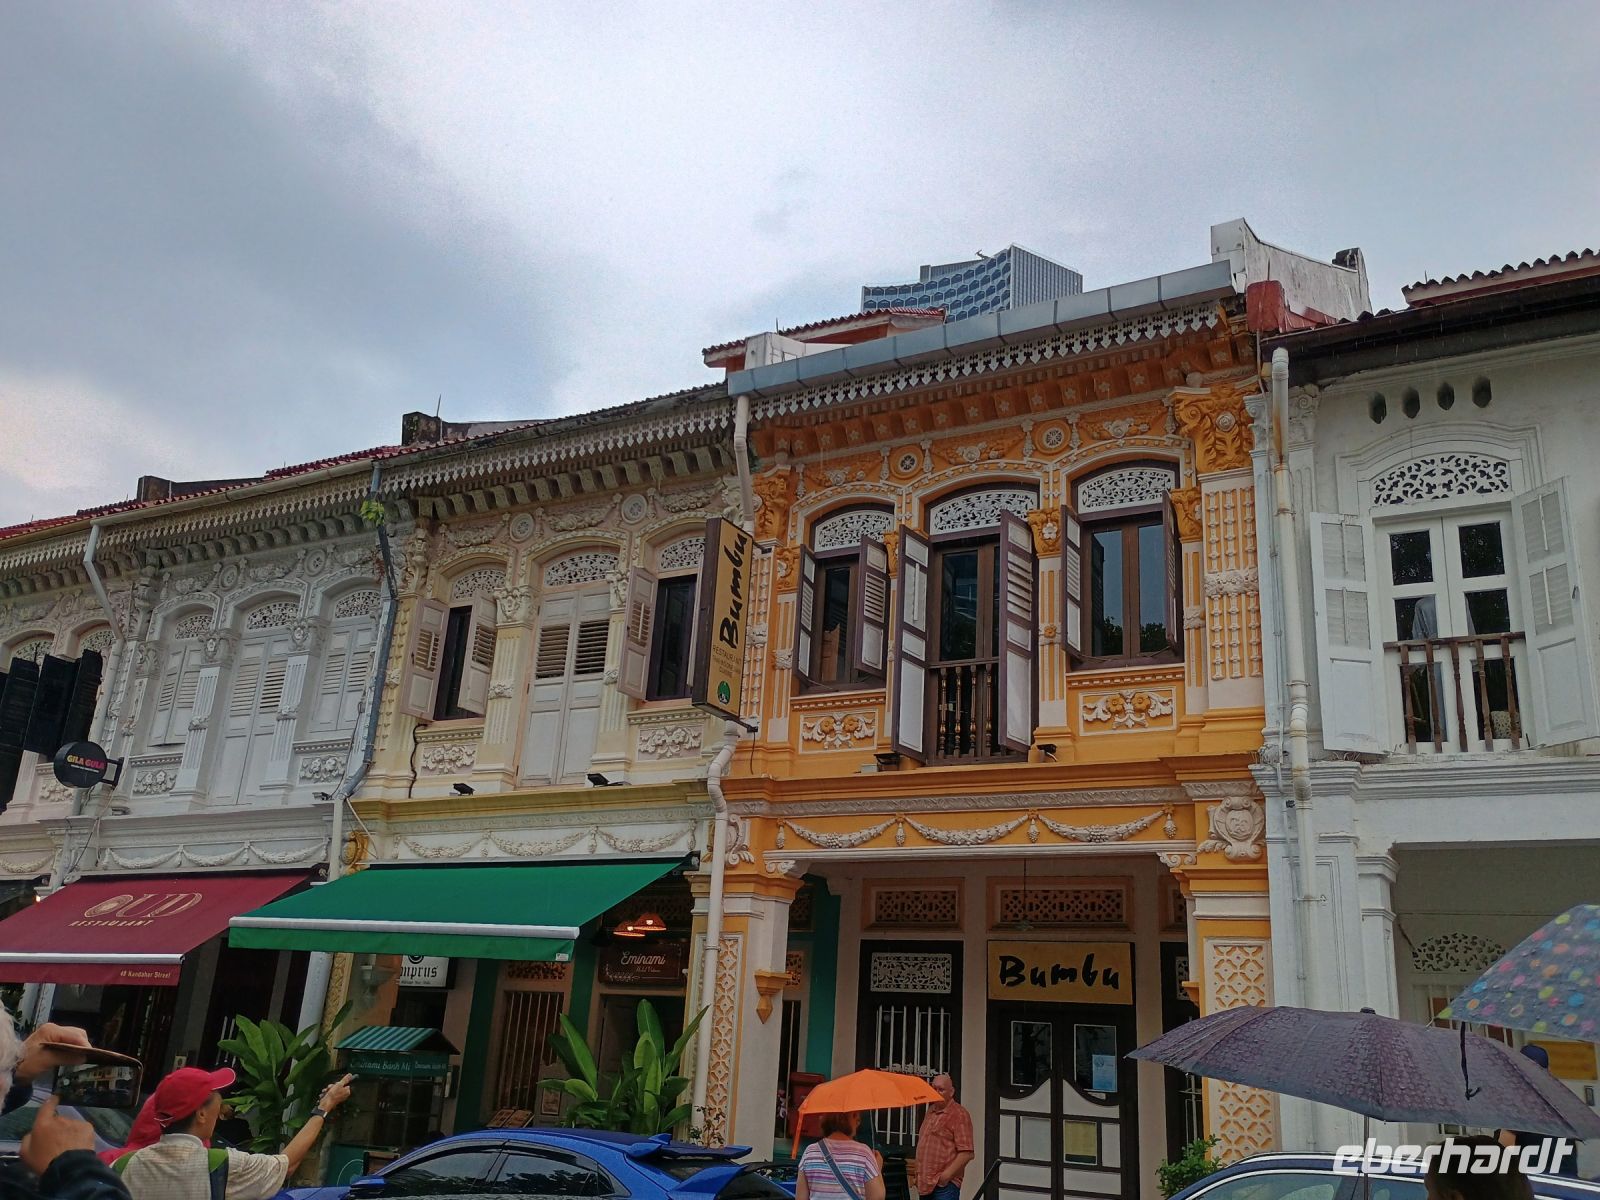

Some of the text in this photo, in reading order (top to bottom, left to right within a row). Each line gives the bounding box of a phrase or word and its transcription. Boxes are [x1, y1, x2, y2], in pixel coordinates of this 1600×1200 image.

[719, 532, 747, 649] Bumbu
[66, 754, 84, 765] GILA
[85, 759, 105, 769] GULA
[84, 892, 202, 918] OUD
[68, 919, 154, 927] RESTAURANT
[620, 950, 666, 965] Eminami
[999, 953, 1119, 990] Bumbu
